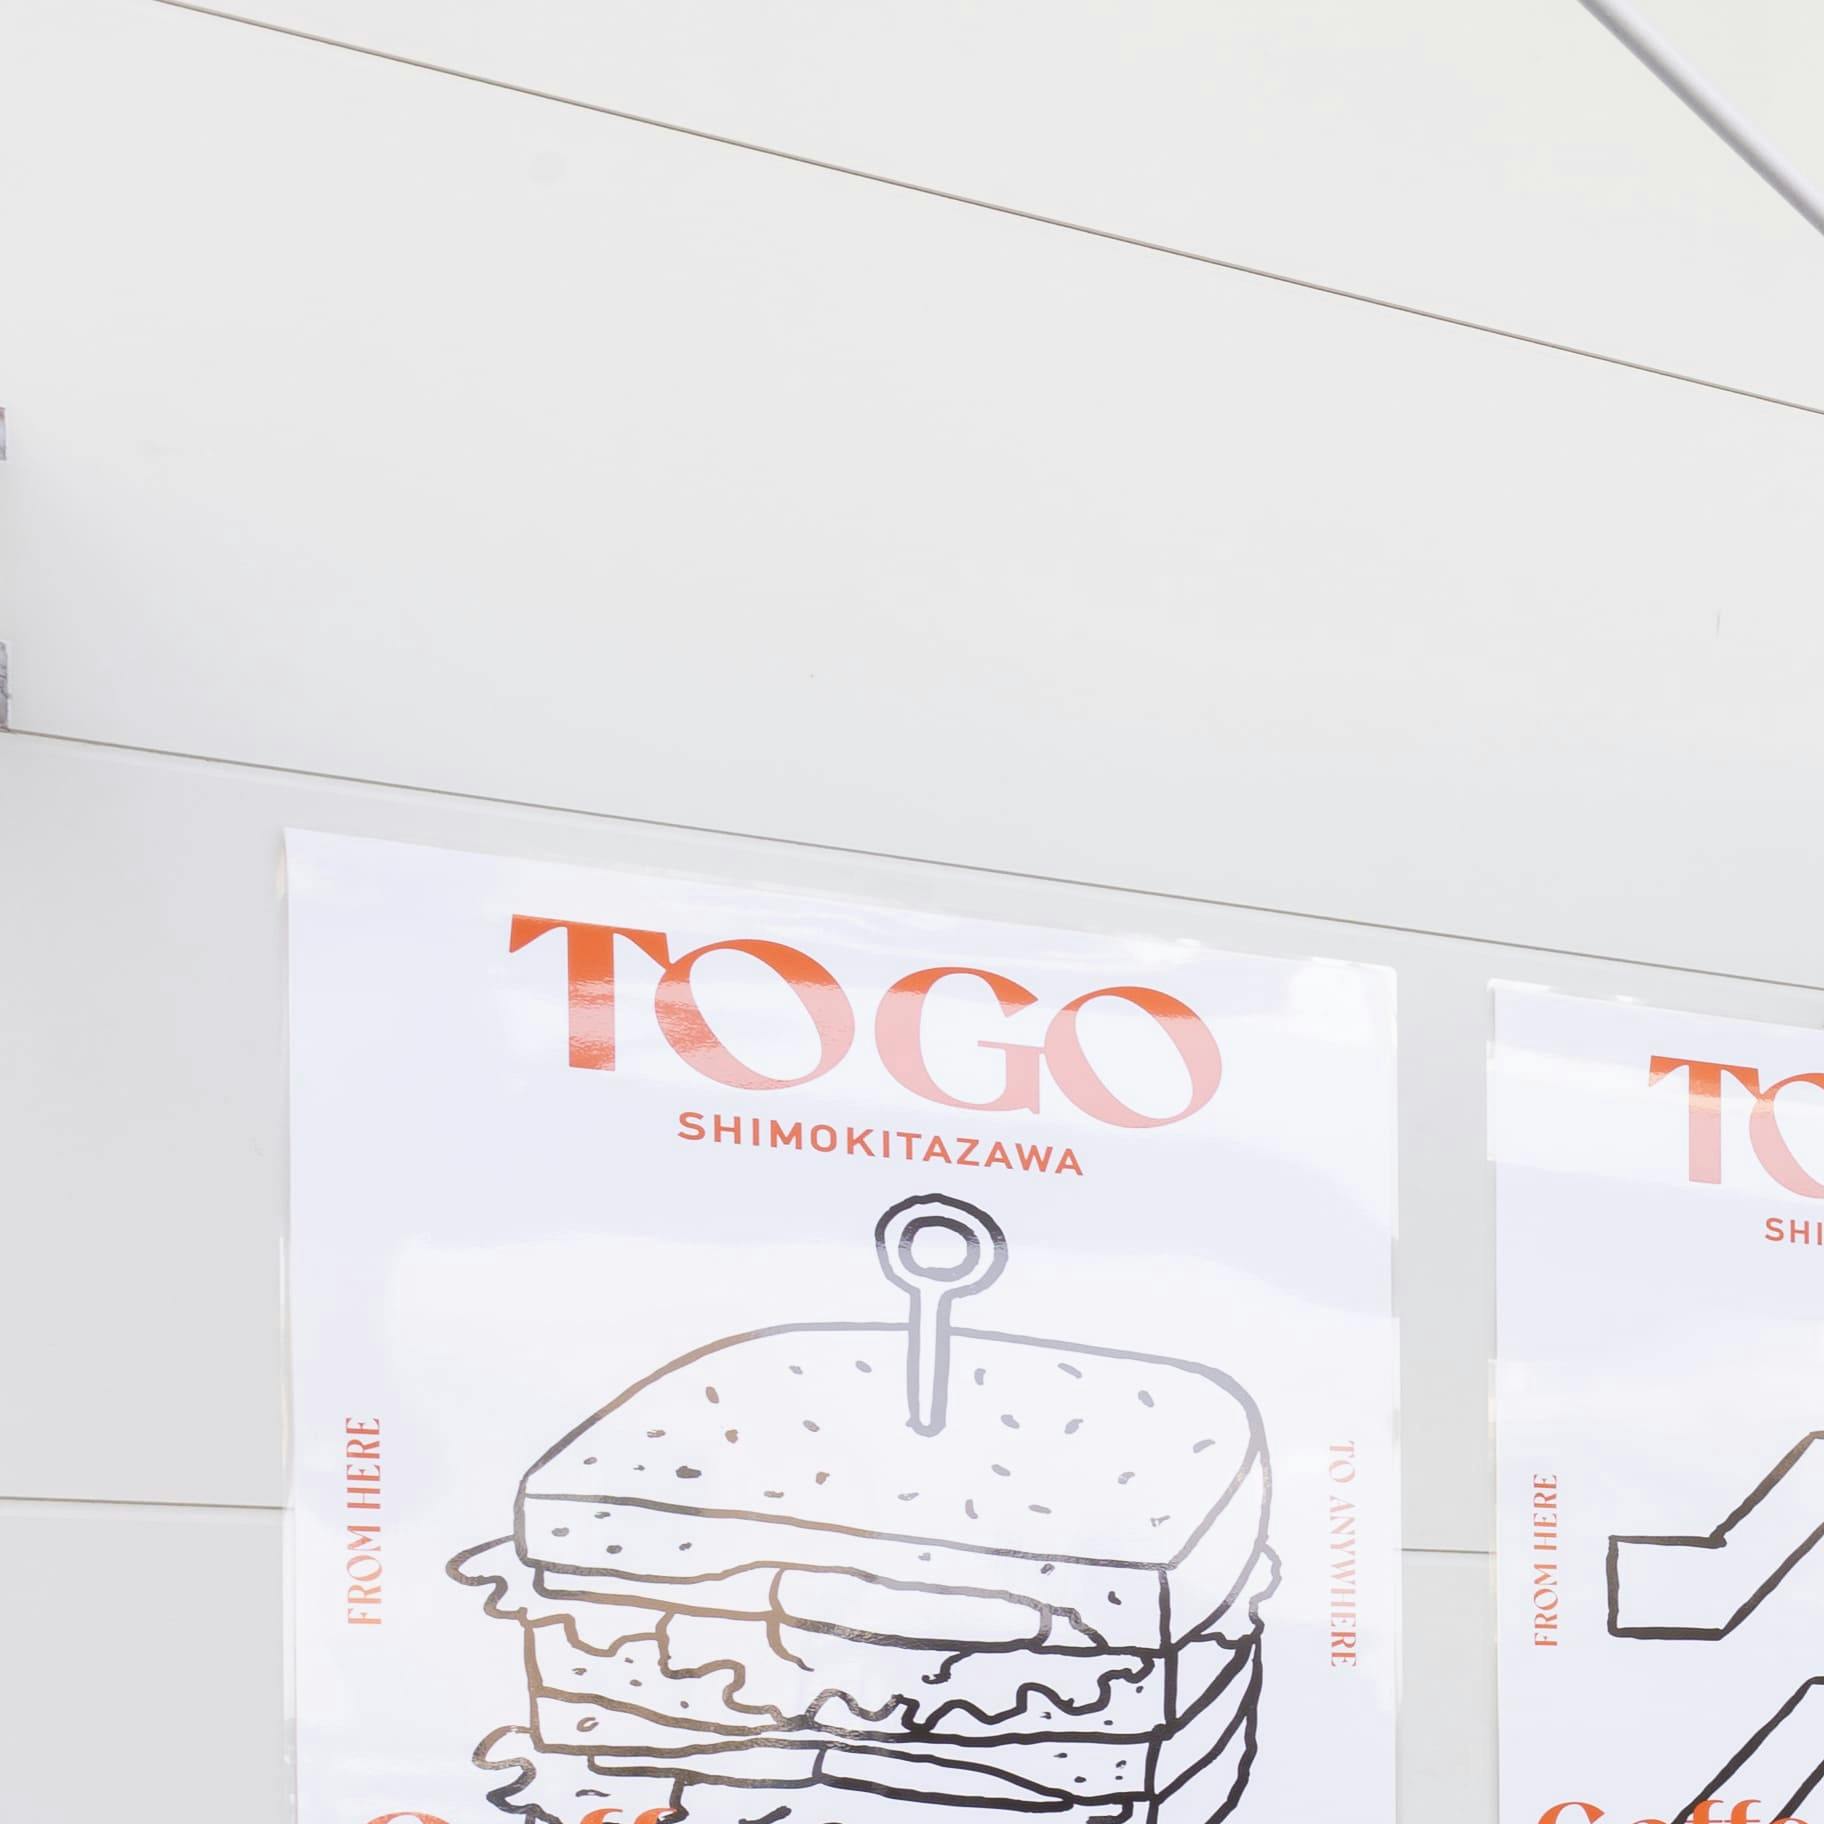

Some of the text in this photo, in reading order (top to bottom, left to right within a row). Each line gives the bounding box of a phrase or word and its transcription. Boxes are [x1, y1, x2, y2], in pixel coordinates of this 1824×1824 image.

[677, 1111, 1085, 1177] SHIMOKITAZAWA
[345, 1417, 384, 1627] FROM HERE
[1329, 1440, 1359, 1668] TO ANYWHERE
[1532, 1473, 1561, 1648] FROM HERE
